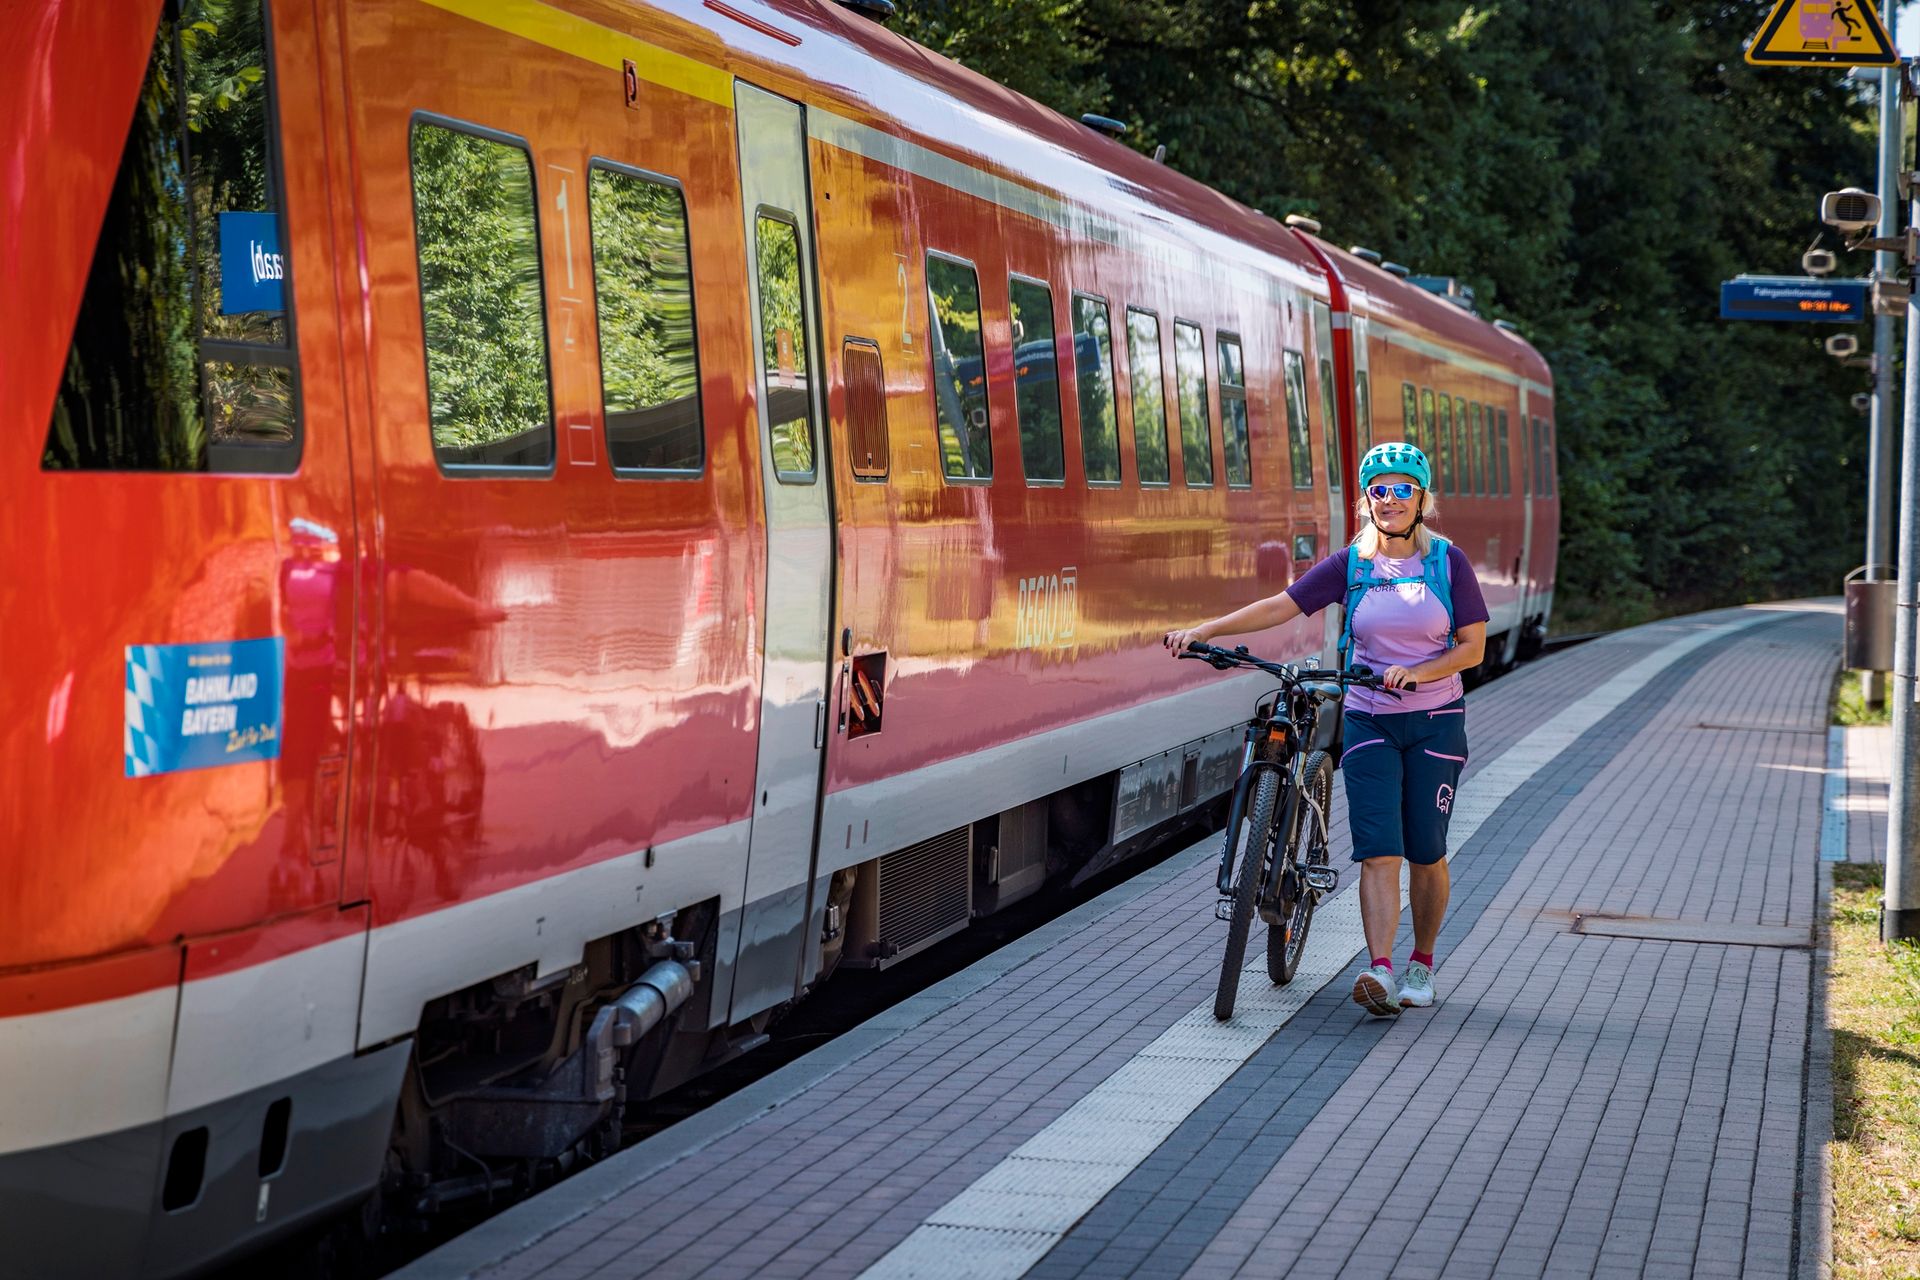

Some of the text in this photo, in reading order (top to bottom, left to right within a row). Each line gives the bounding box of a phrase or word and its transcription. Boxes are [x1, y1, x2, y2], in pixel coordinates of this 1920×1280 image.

[555, 179, 575, 289] 1
[897, 262, 913, 345] 2
[1016, 574, 1059, 649] REGIO
[181, 704, 238, 736] BAYERN
[185, 673, 258, 705] BAHNLAND
